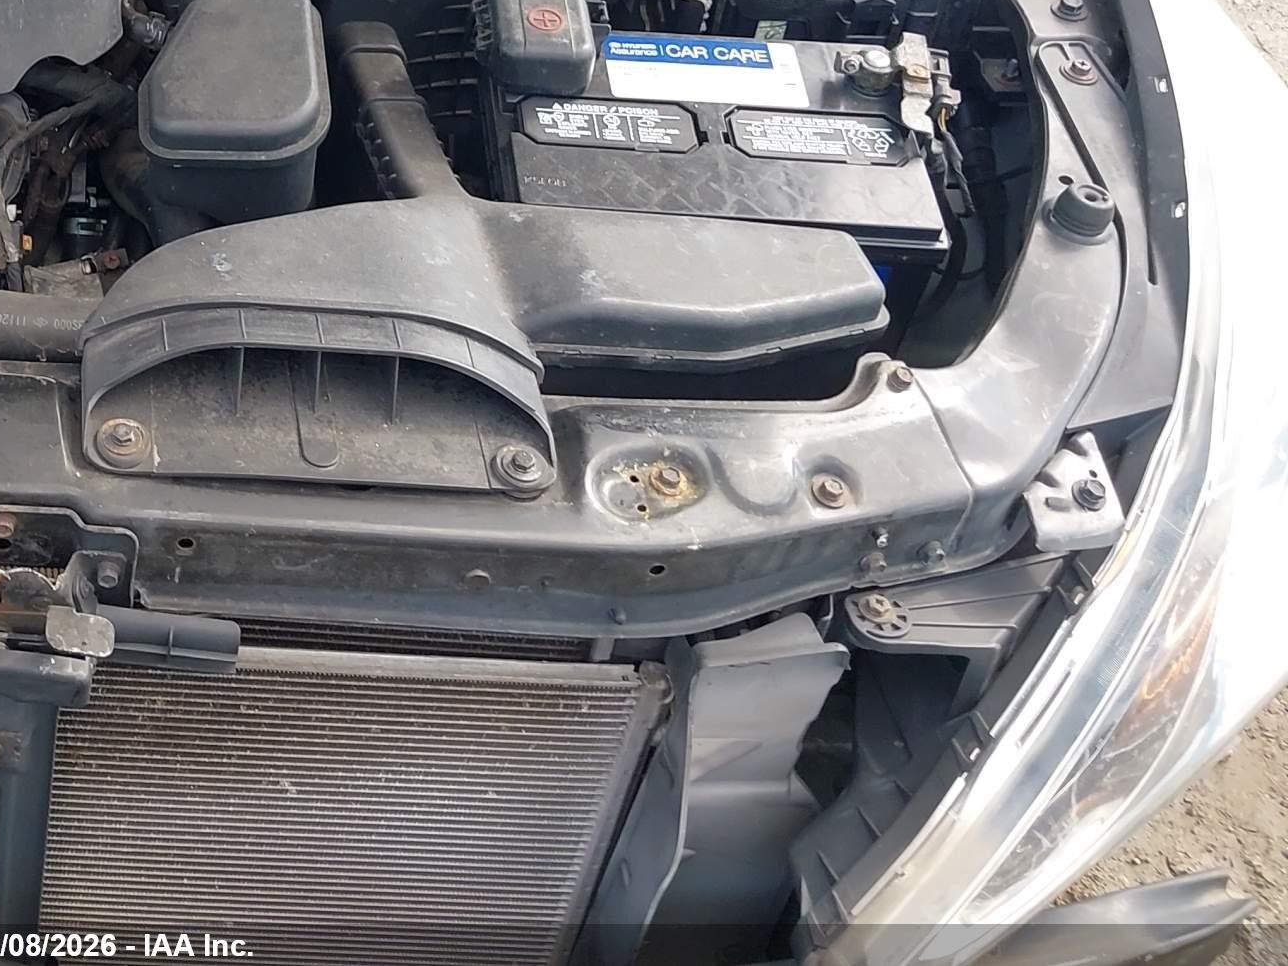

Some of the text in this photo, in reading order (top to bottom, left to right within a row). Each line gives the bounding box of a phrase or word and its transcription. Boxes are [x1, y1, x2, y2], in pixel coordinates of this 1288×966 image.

[665, 44, 770, 63] CAR CARE
[563, 103, 608, 113] DANGER
[618, 106, 659, 115] POISON
